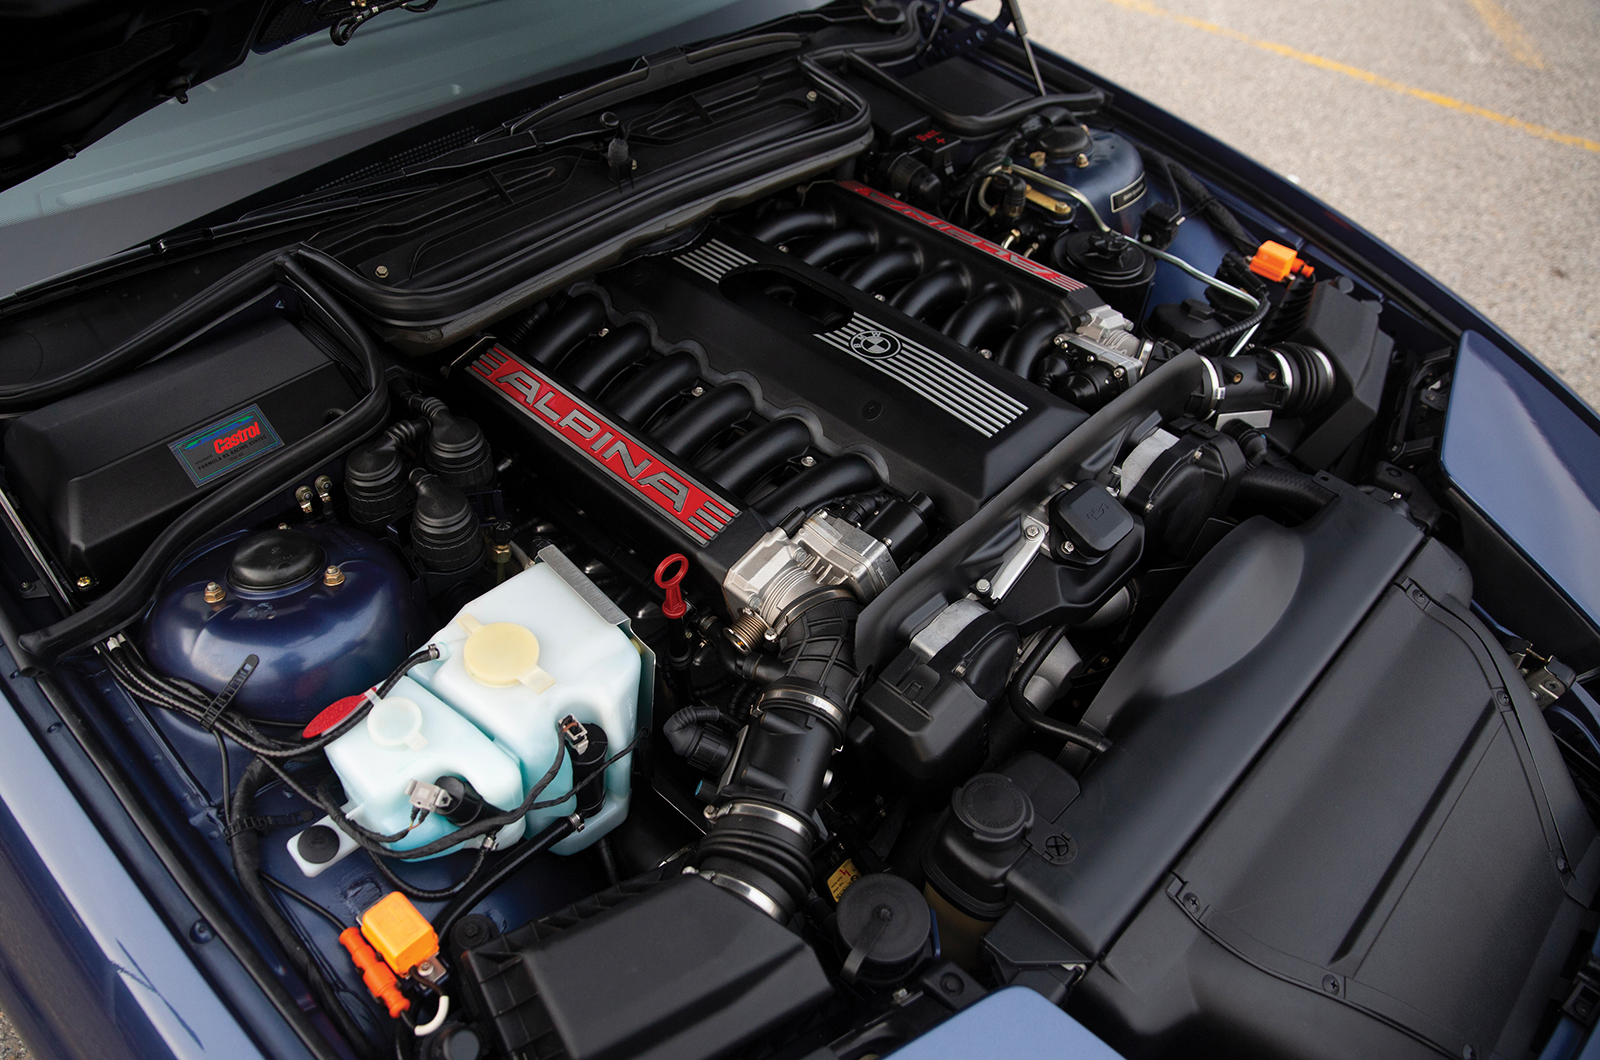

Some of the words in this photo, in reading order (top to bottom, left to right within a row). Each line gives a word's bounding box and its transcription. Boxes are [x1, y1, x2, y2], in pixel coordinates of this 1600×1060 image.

[868, 191, 1056, 275] ALPINA
[198, 455, 222, 471] FORMULA
[230, 443, 249, 455] RACING
[249, 434, 268, 447] SYNTEC
[213, 421, 261, 454] Castrol
[496, 370, 691, 514] ALPINA
